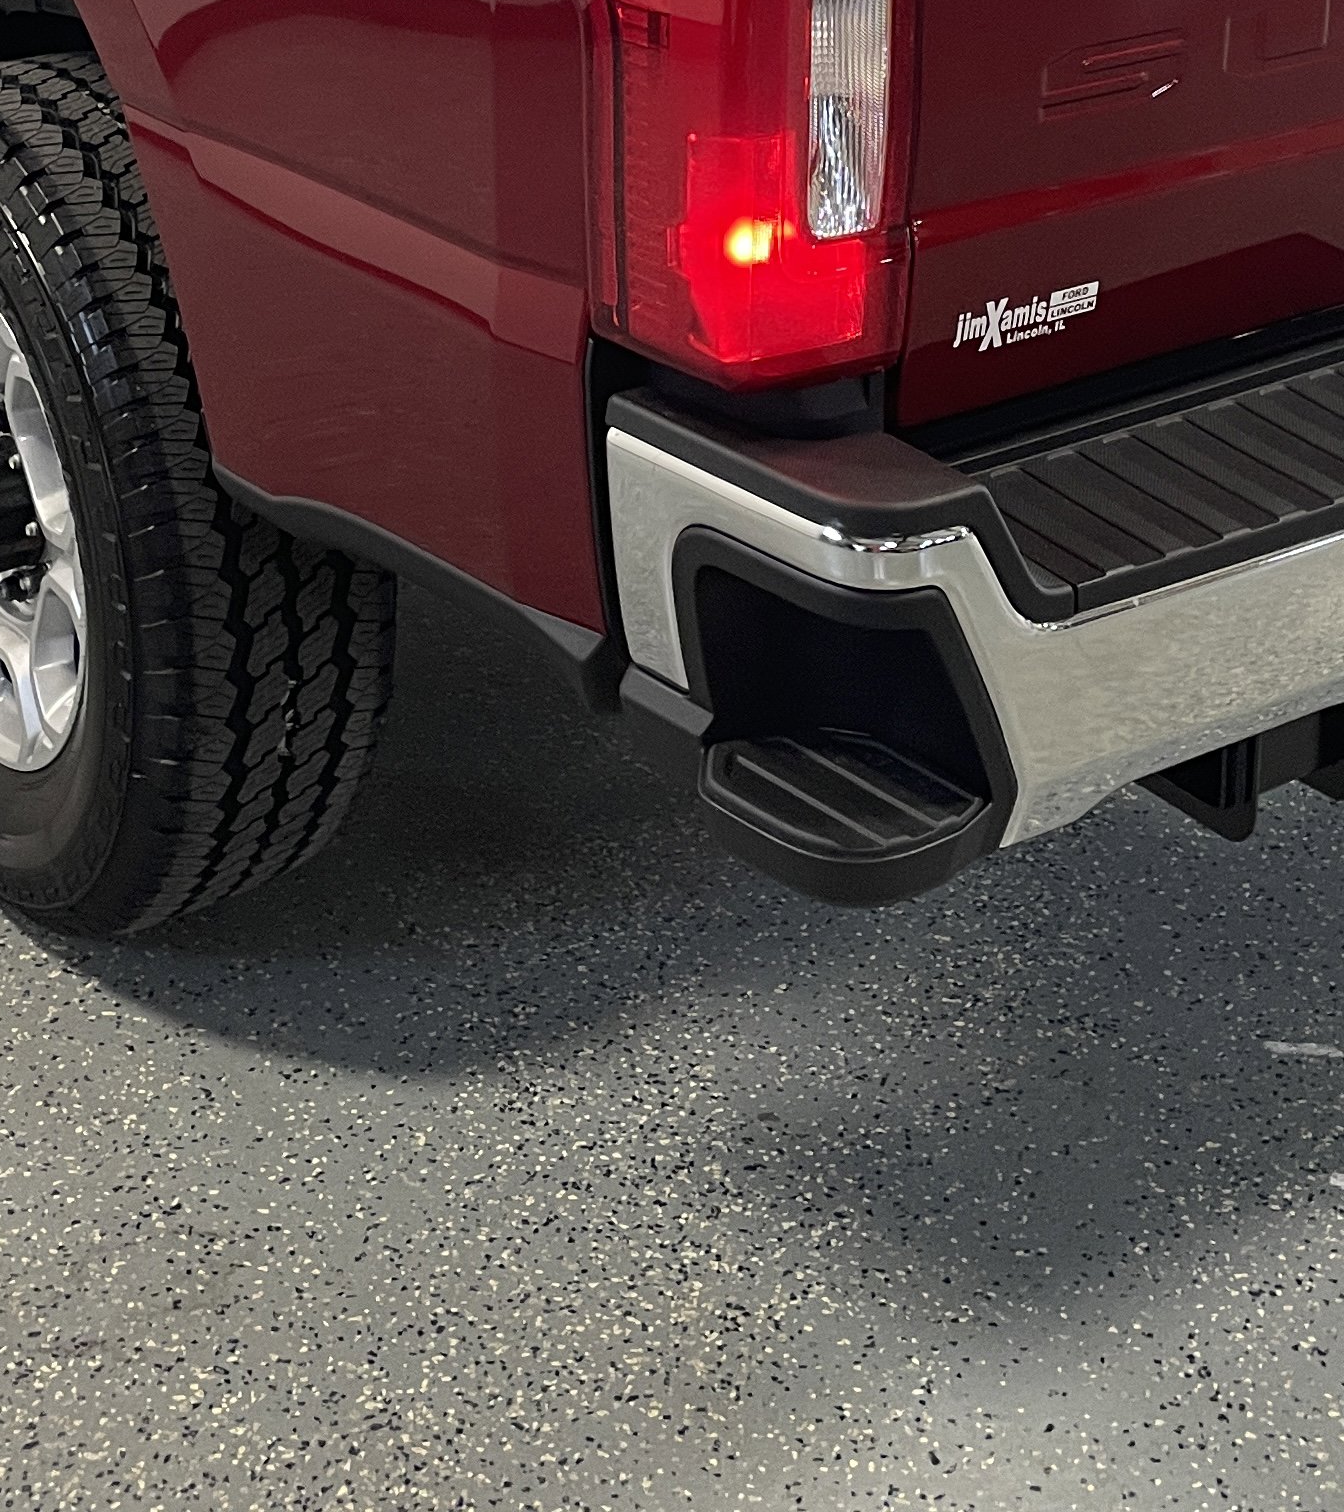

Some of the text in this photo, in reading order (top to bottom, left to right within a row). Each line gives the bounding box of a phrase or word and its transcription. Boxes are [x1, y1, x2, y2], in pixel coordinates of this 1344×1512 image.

[1062, 286, 1090, 301] FORD
[1051, 299, 1095, 319] LINCOLN
[1006, 319, 1066, 344] Lincoln, IL
